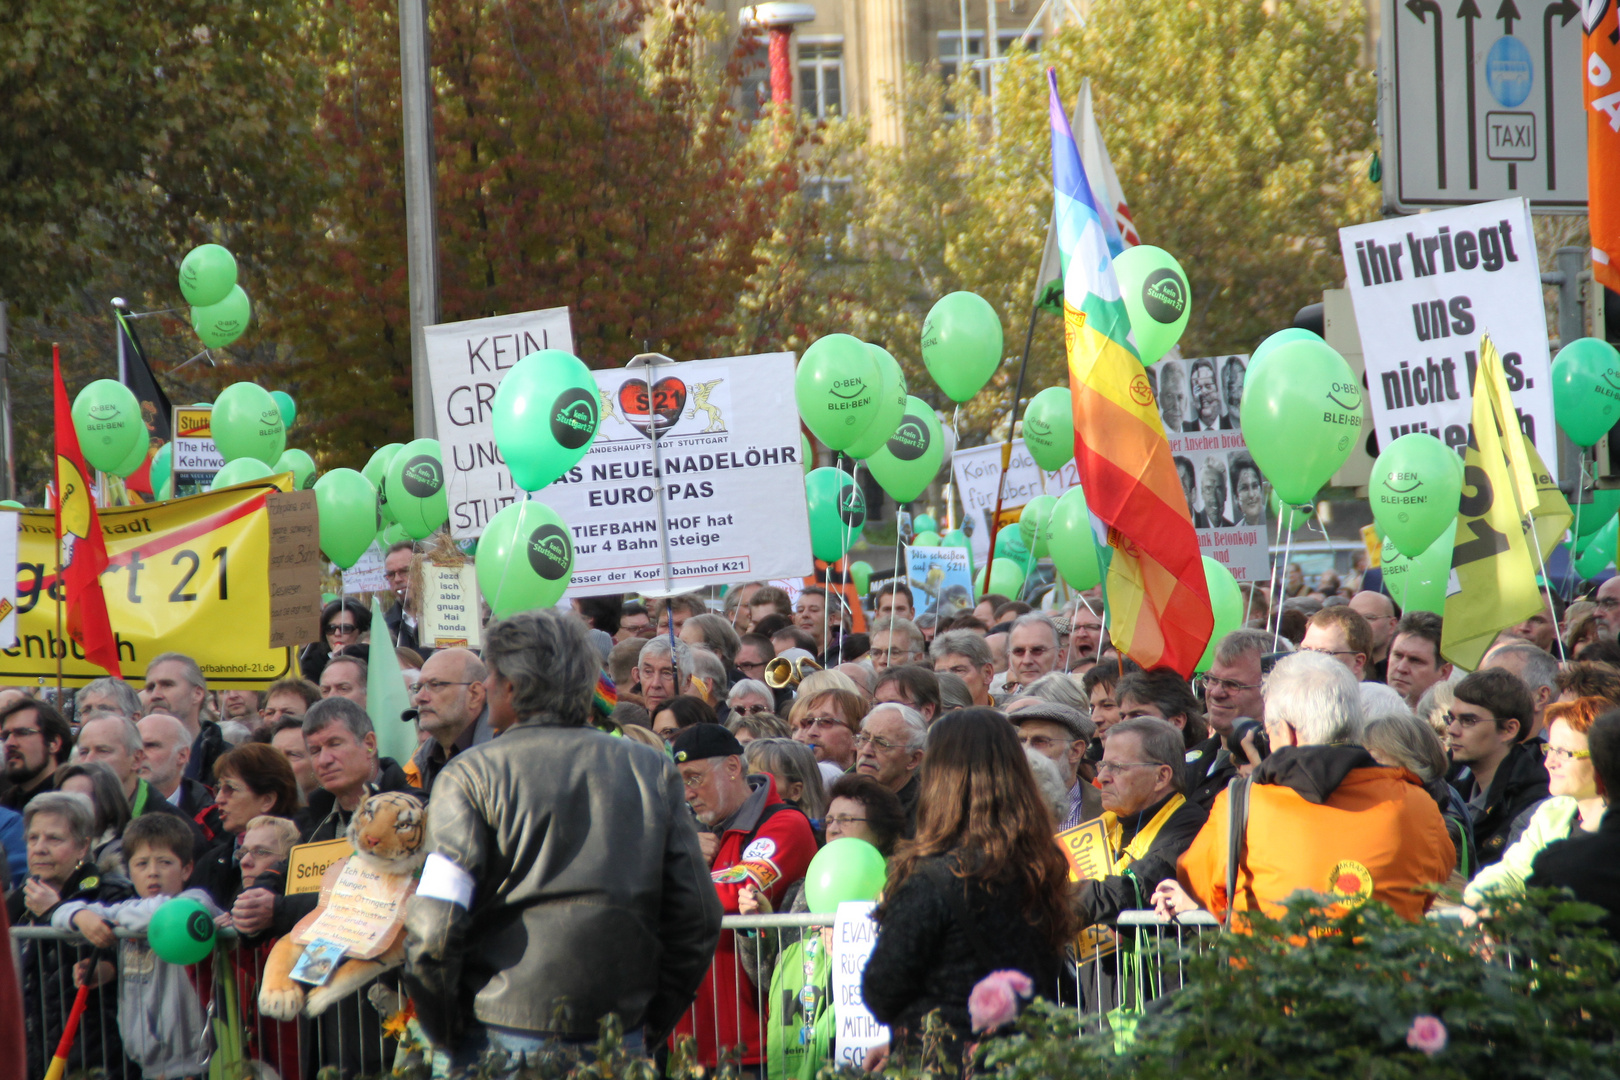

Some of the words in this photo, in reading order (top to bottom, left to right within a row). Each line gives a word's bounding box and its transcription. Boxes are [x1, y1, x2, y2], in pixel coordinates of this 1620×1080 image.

[1492, 125, 1531, 147] TAXI
[1355, 238, 1403, 287] ihr
[1407, 218, 1518, 272] kriegt
[1163, 286, 1177, 298] kein
[1147, 288, 1175, 307] Stuttgart
[1175, 301, 1182, 311] 21
[1412, 294, 1476, 342] uns
[467, 329, 548, 375] KEIN
[833, 377, 862, 388] O-BEN
[1381, 354, 1460, 411] nicht
[1465, 350, 1534, 397] ls.
[1331, 382, 1359, 394] O-BEN
[91, 404, 116, 412] O-BEN
[447, 382, 499, 427] GR
[827, 397, 871, 411] BLEI-BEN!
[573, 410, 588, 421] kein
[87, 422, 125, 431] BLEI-BEN!
[181, 415, 211, 430] Stutt
[555, 413, 587, 431] Stuttgart
[587, 424, 594, 434] 21
[903, 429, 916, 440] kein
[177, 441, 198, 452] The
[201, 441, 217, 452] Ho
[678, 436, 729, 447] STUTTGART
[917, 441, 925, 449] 21
[1184, 434, 1220, 451] Ansehen
[591, 459, 654, 482] NEUE
[665, 446, 798, 475] NADELÖHR
[1388, 472, 1418, 481] O-BEN
[968, 487, 993, 509] für
[1381, 495, 1427, 504] BLEI-BEN!
[707, 513, 733, 527] hat
[549, 542, 562, 555] kein
[573, 542, 597, 555] nur
[602, 539, 612, 552] 4
[532, 543, 560, 566] Stuttgart
[560, 561, 568, 570] 21
[930, 549, 965, 560] scheißen
[570, 573, 601, 584] esser
[607, 571, 626, 582] der
[722, 560, 745, 572] K21
[912, 562, 926, 572] auf
[946, 563, 966, 572] S21!
[168, 546, 228, 603] 21
[438, 572, 459, 580] Jezd
[437, 604, 465, 612] gnuag
[438, 623, 466, 631] honda
[344, 866, 358, 875] Ich
[361, 870, 380, 880] habe
[761, 868, 774, 880] 21
[339, 879, 367, 891] Hunger
